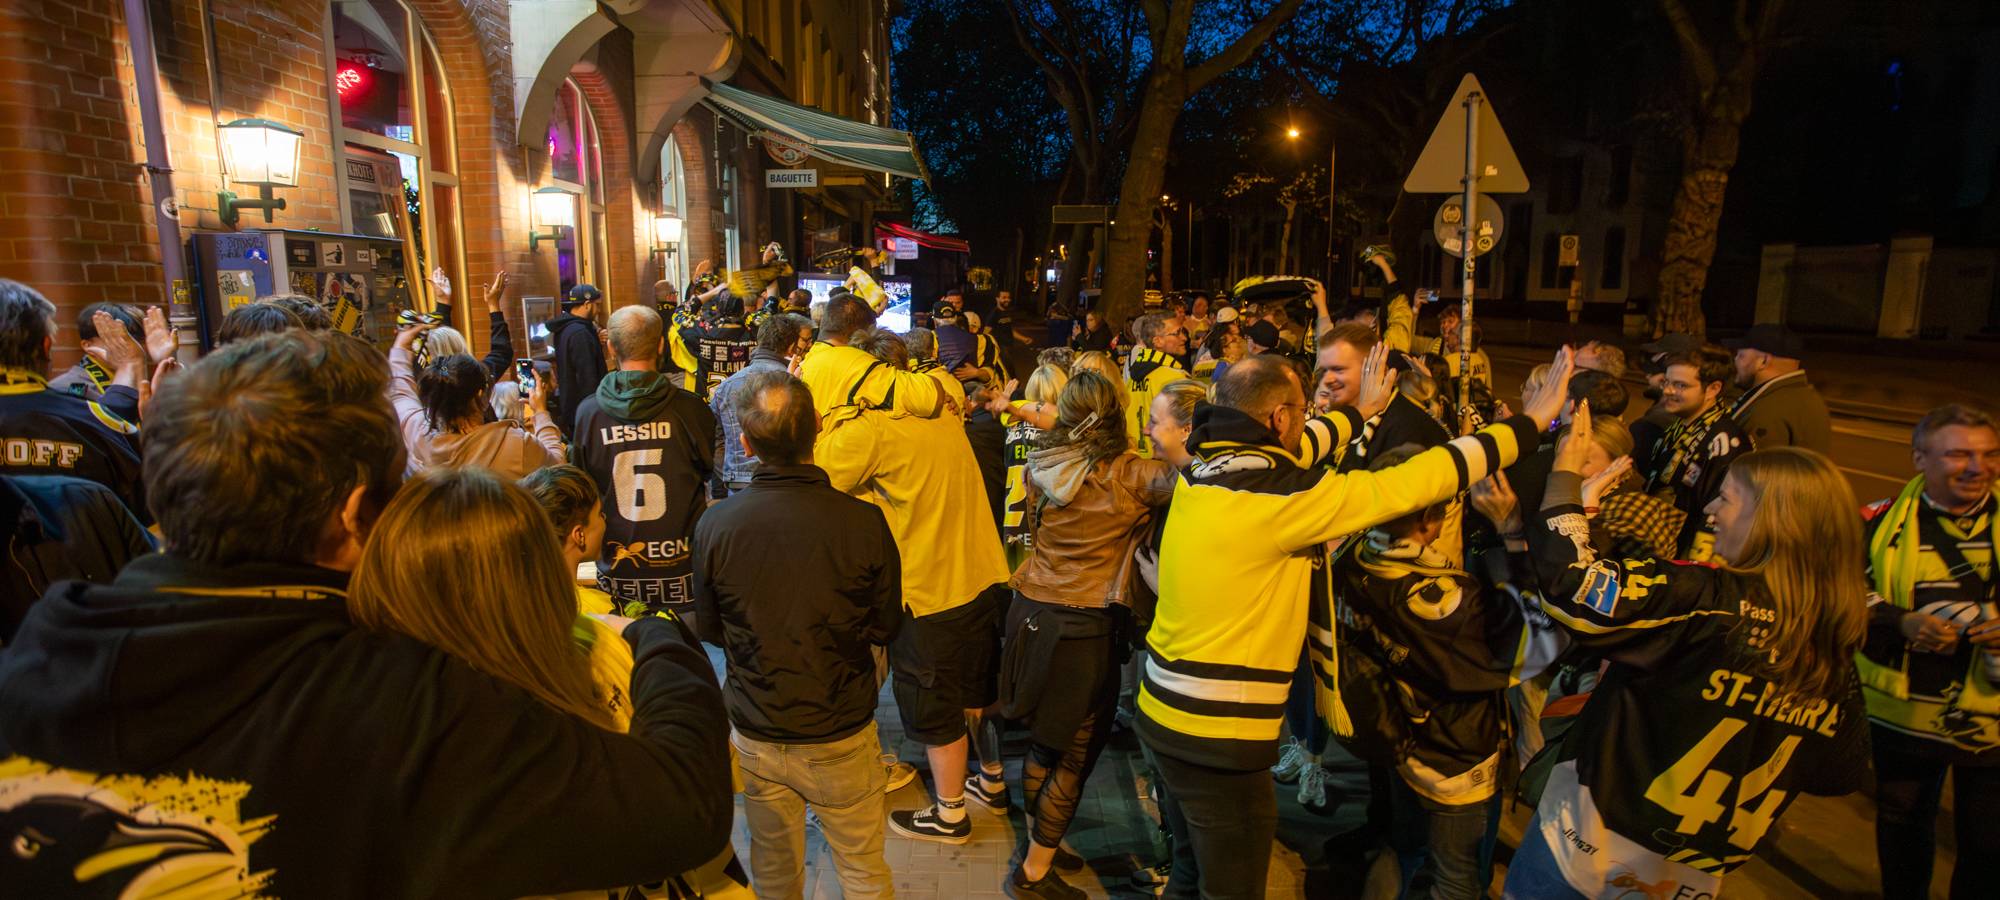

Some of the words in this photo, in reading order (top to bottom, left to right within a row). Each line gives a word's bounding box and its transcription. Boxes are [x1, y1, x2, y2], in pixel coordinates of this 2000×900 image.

[770, 173, 812, 183] BAGUETTE
[600, 421, 671, 446] LESSIO
[0, 437, 83, 468] OFF
[612, 448, 667, 522] 6
[647, 536, 689, 557] EGN
[1739, 599, 1776, 623] Pass
[1643, 717, 1803, 851] 44
